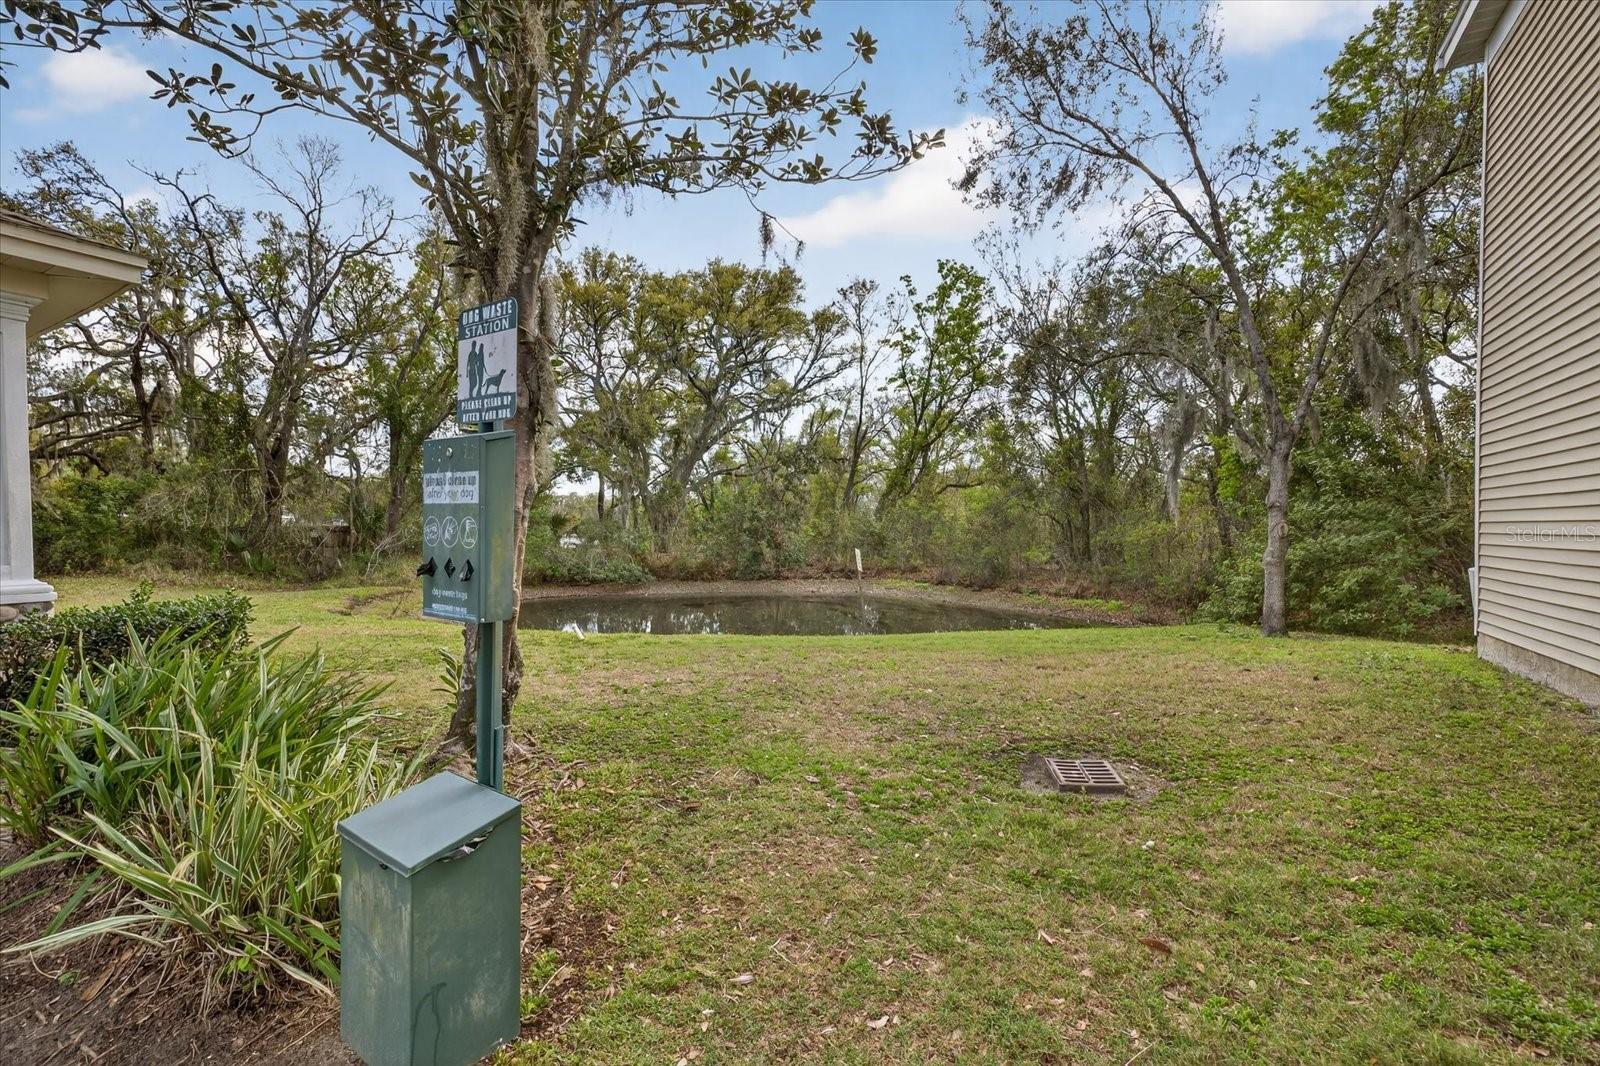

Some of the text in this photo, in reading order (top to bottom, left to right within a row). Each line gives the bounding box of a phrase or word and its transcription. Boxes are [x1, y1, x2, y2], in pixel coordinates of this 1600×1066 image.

[462, 300, 512, 325] DOG WASTE
[465, 318, 509, 338] STATION
[460, 488, 474, 500] dog
